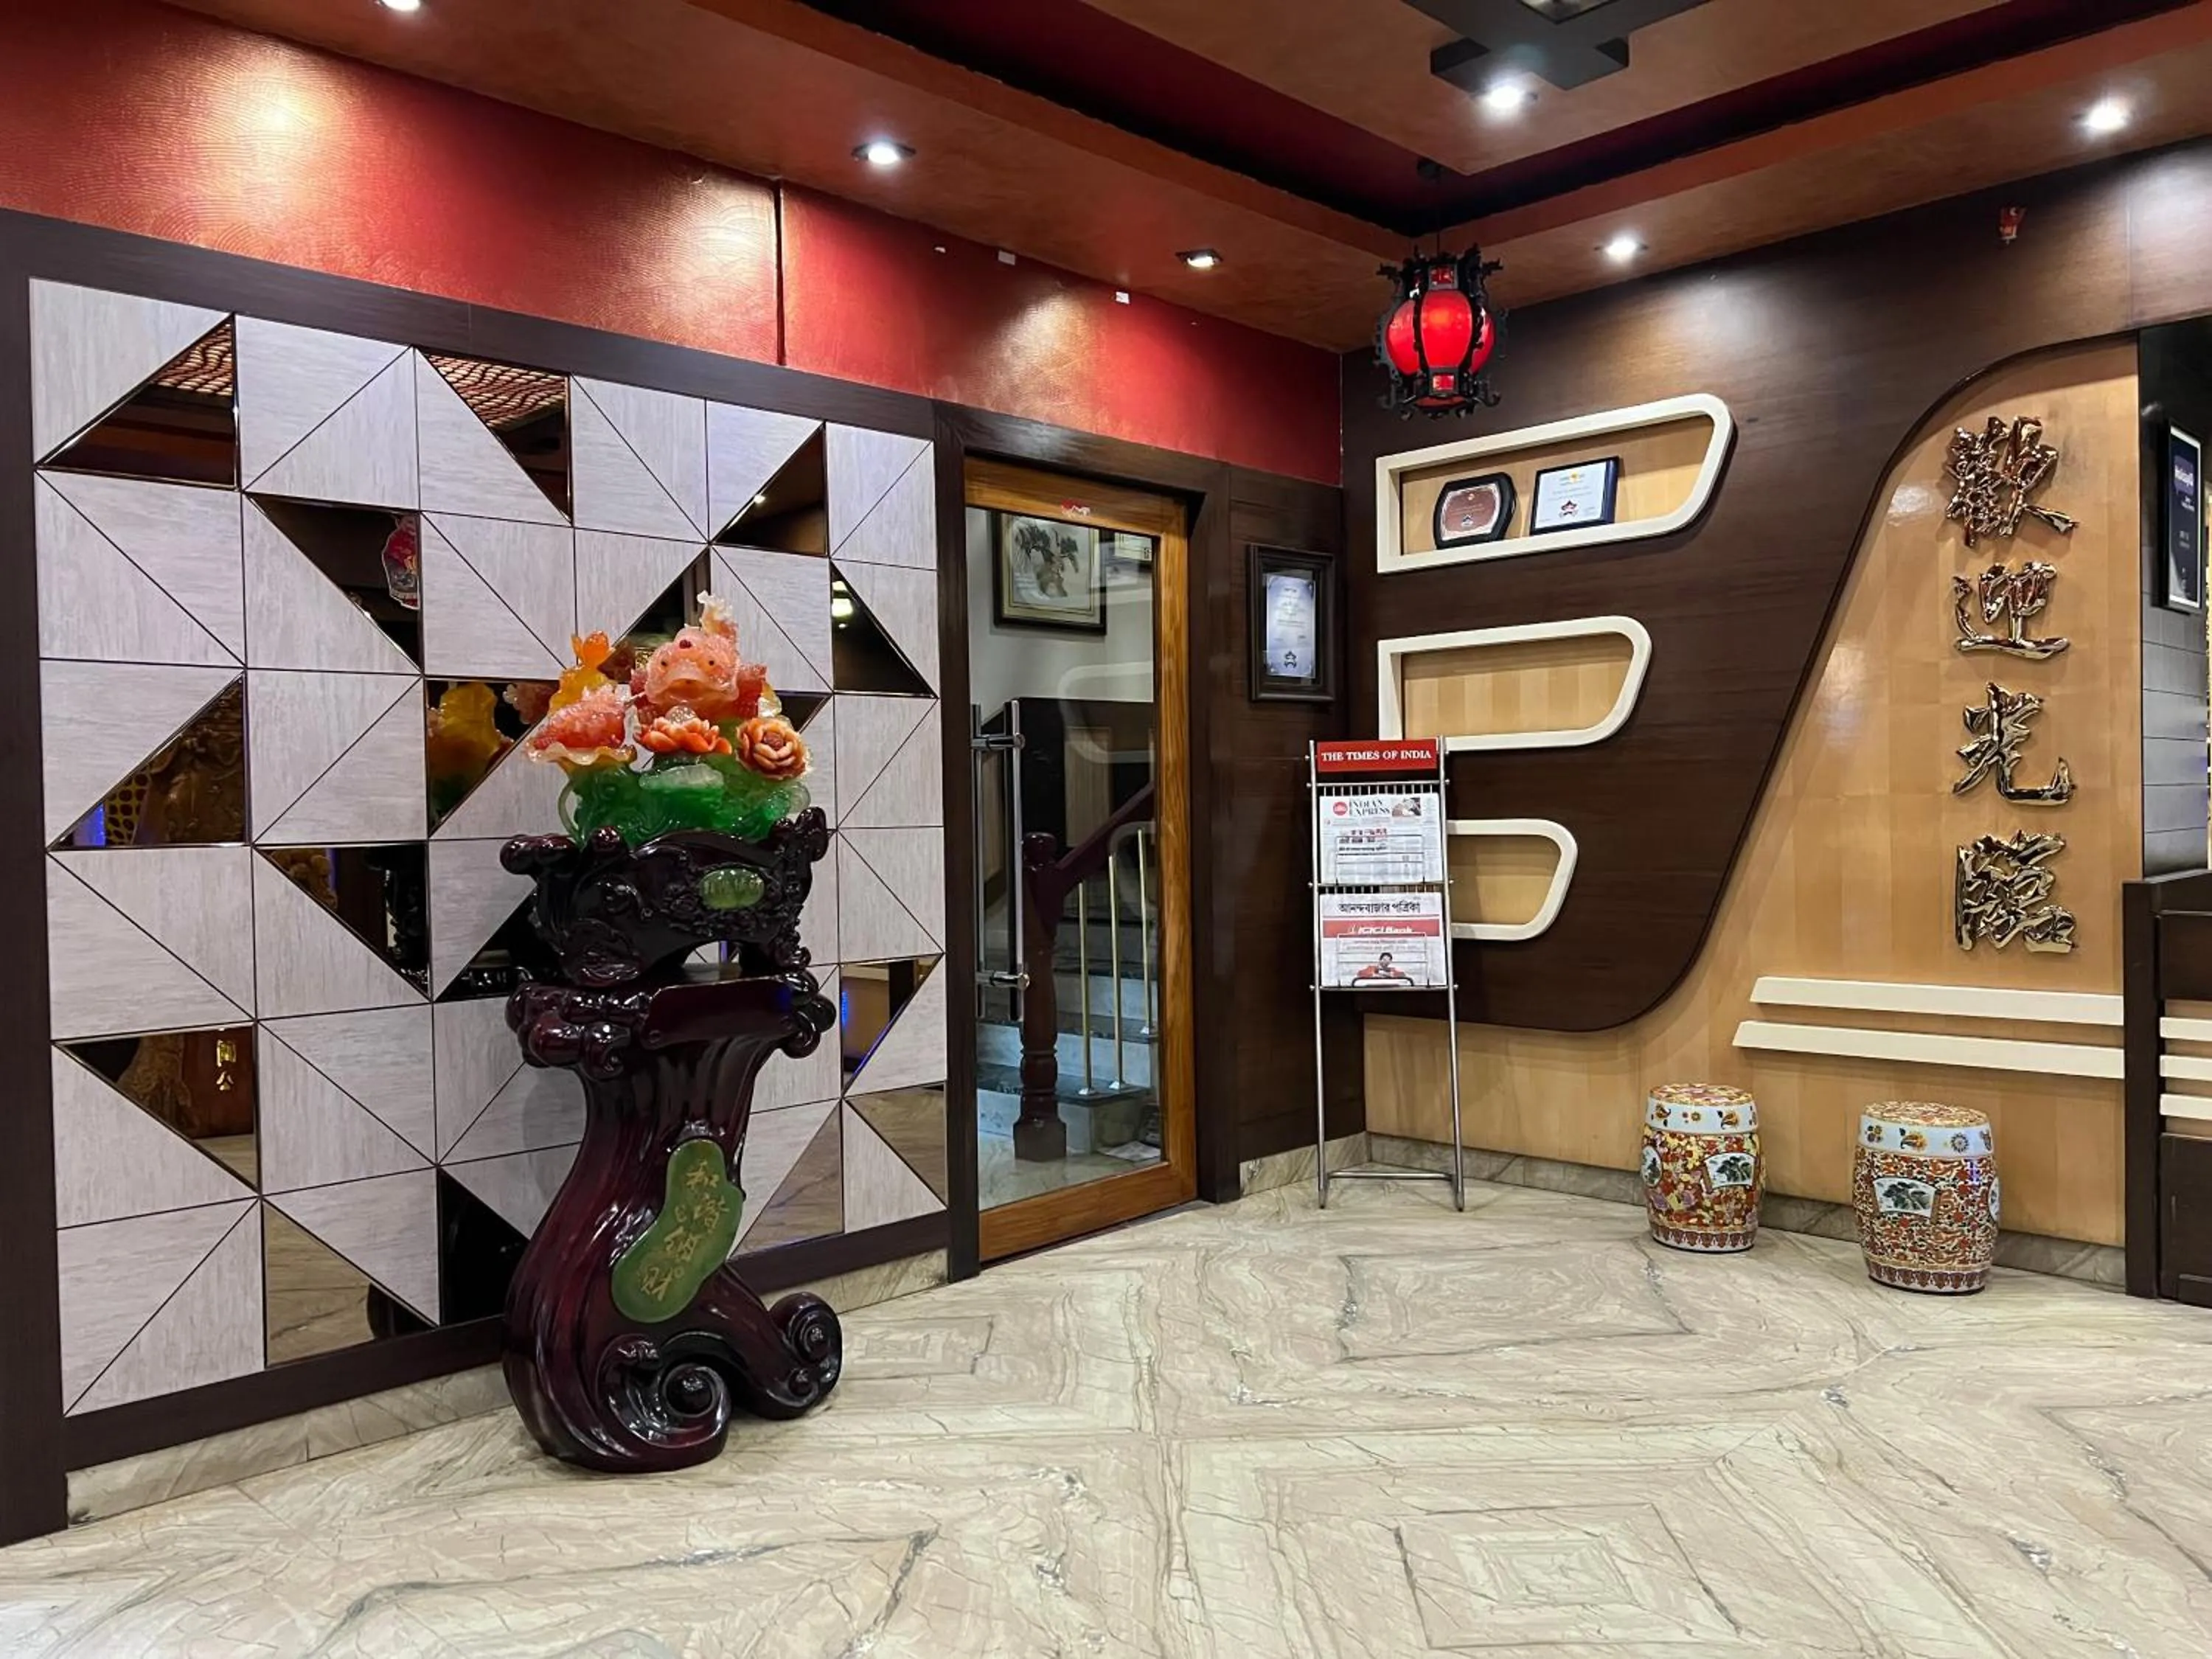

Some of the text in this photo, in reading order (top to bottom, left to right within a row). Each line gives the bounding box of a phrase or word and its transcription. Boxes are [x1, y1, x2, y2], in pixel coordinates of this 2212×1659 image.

[1321, 750, 1431, 762] THE TIMES OF INDIA
